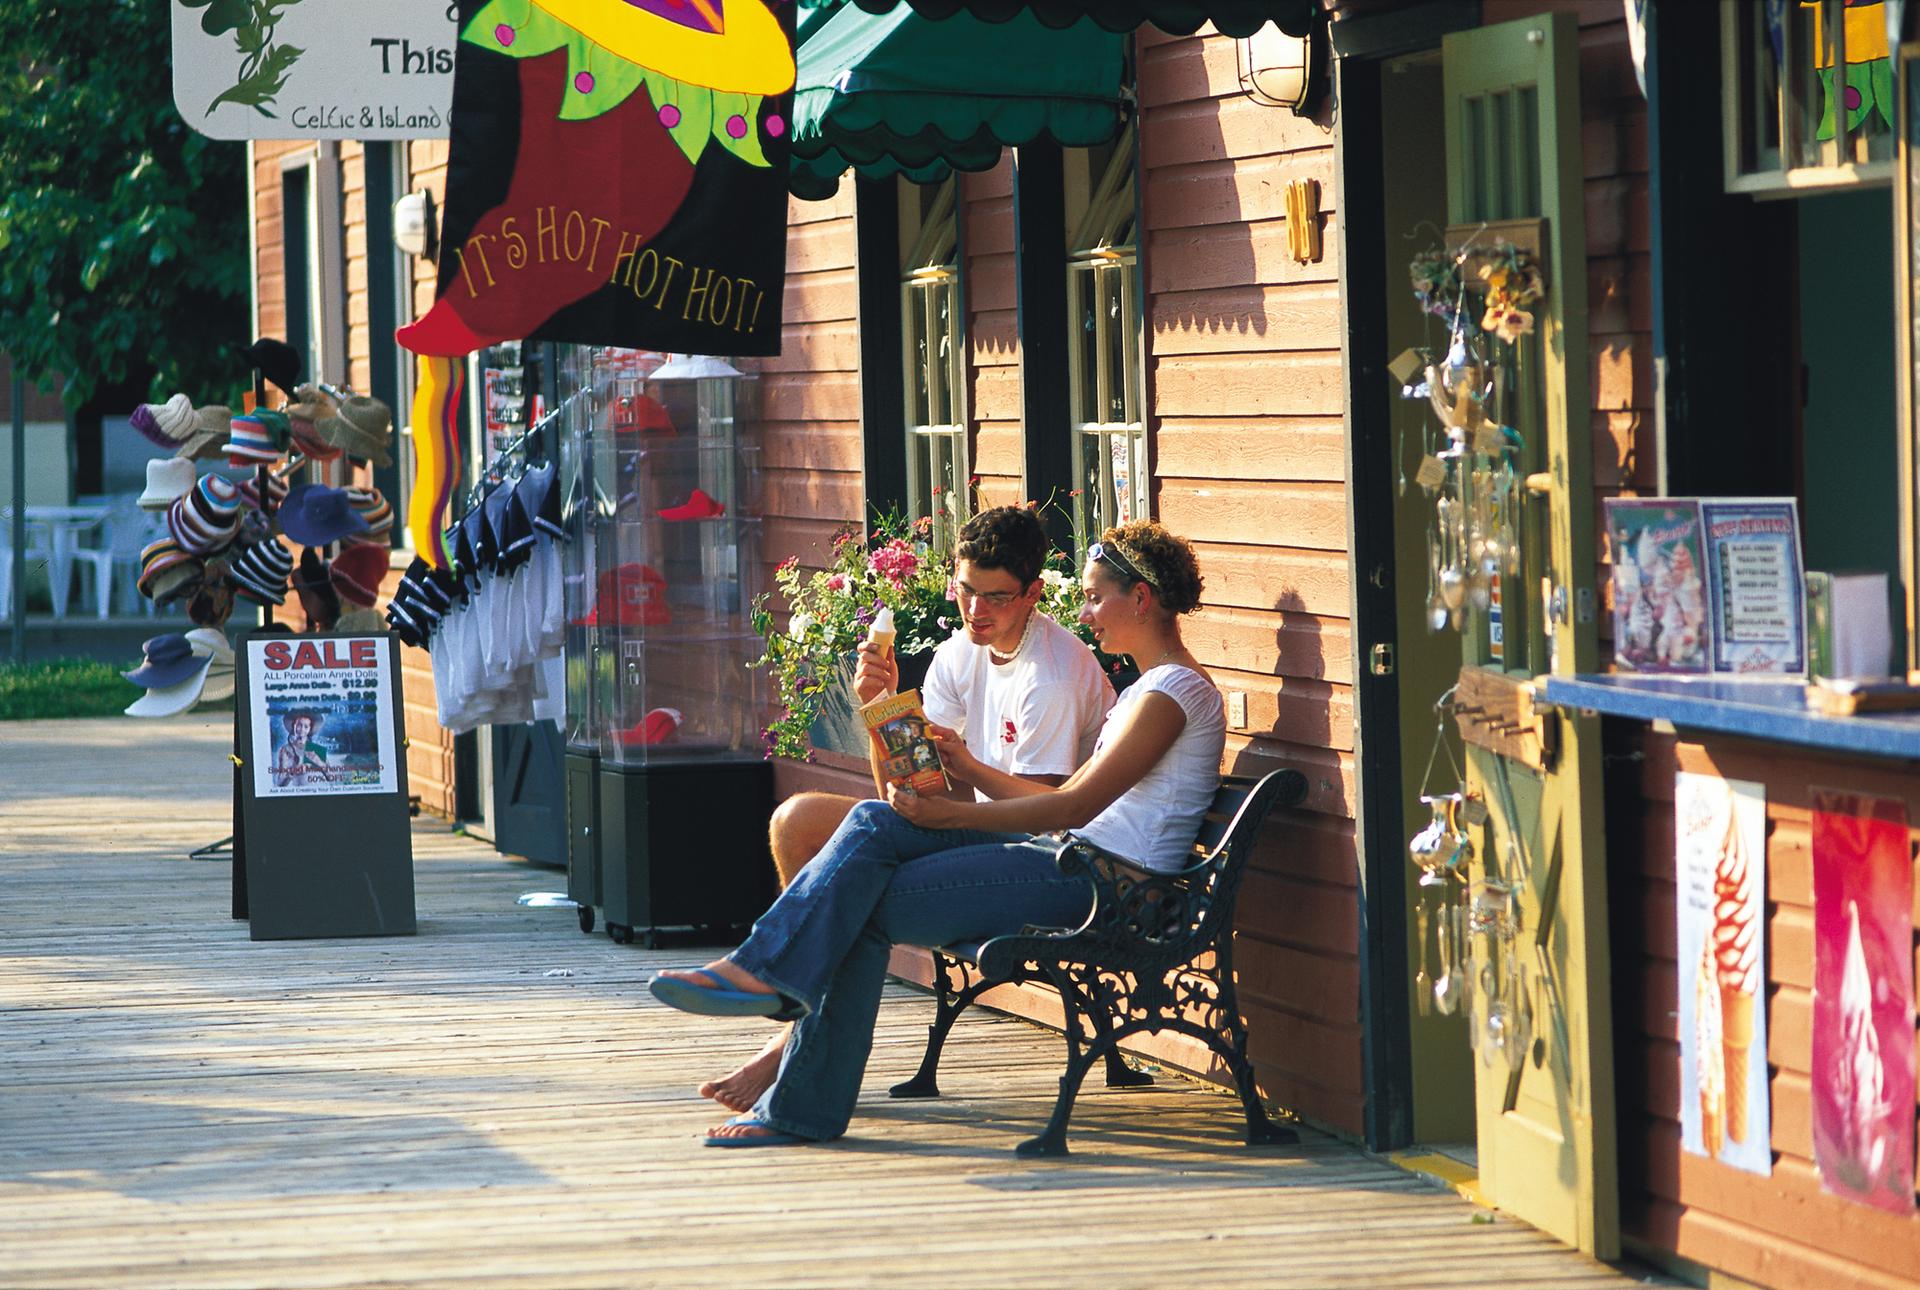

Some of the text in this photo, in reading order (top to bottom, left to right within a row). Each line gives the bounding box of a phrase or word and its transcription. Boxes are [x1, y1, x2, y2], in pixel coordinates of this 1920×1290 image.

[370, 38, 457, 74] This
[360, 106, 374, 128] &
[453, 206, 764, 334] IT'S HOT HOT HOT!
[264, 640, 378, 670] SALE
[264, 669, 378, 680] ALL Porcelain Anne Dolls
[265, 682, 288, 691] Large
[289, 681, 310, 690] Anne
[311, 680, 331, 689] Dolls
[299, 694, 320, 702] Anne
